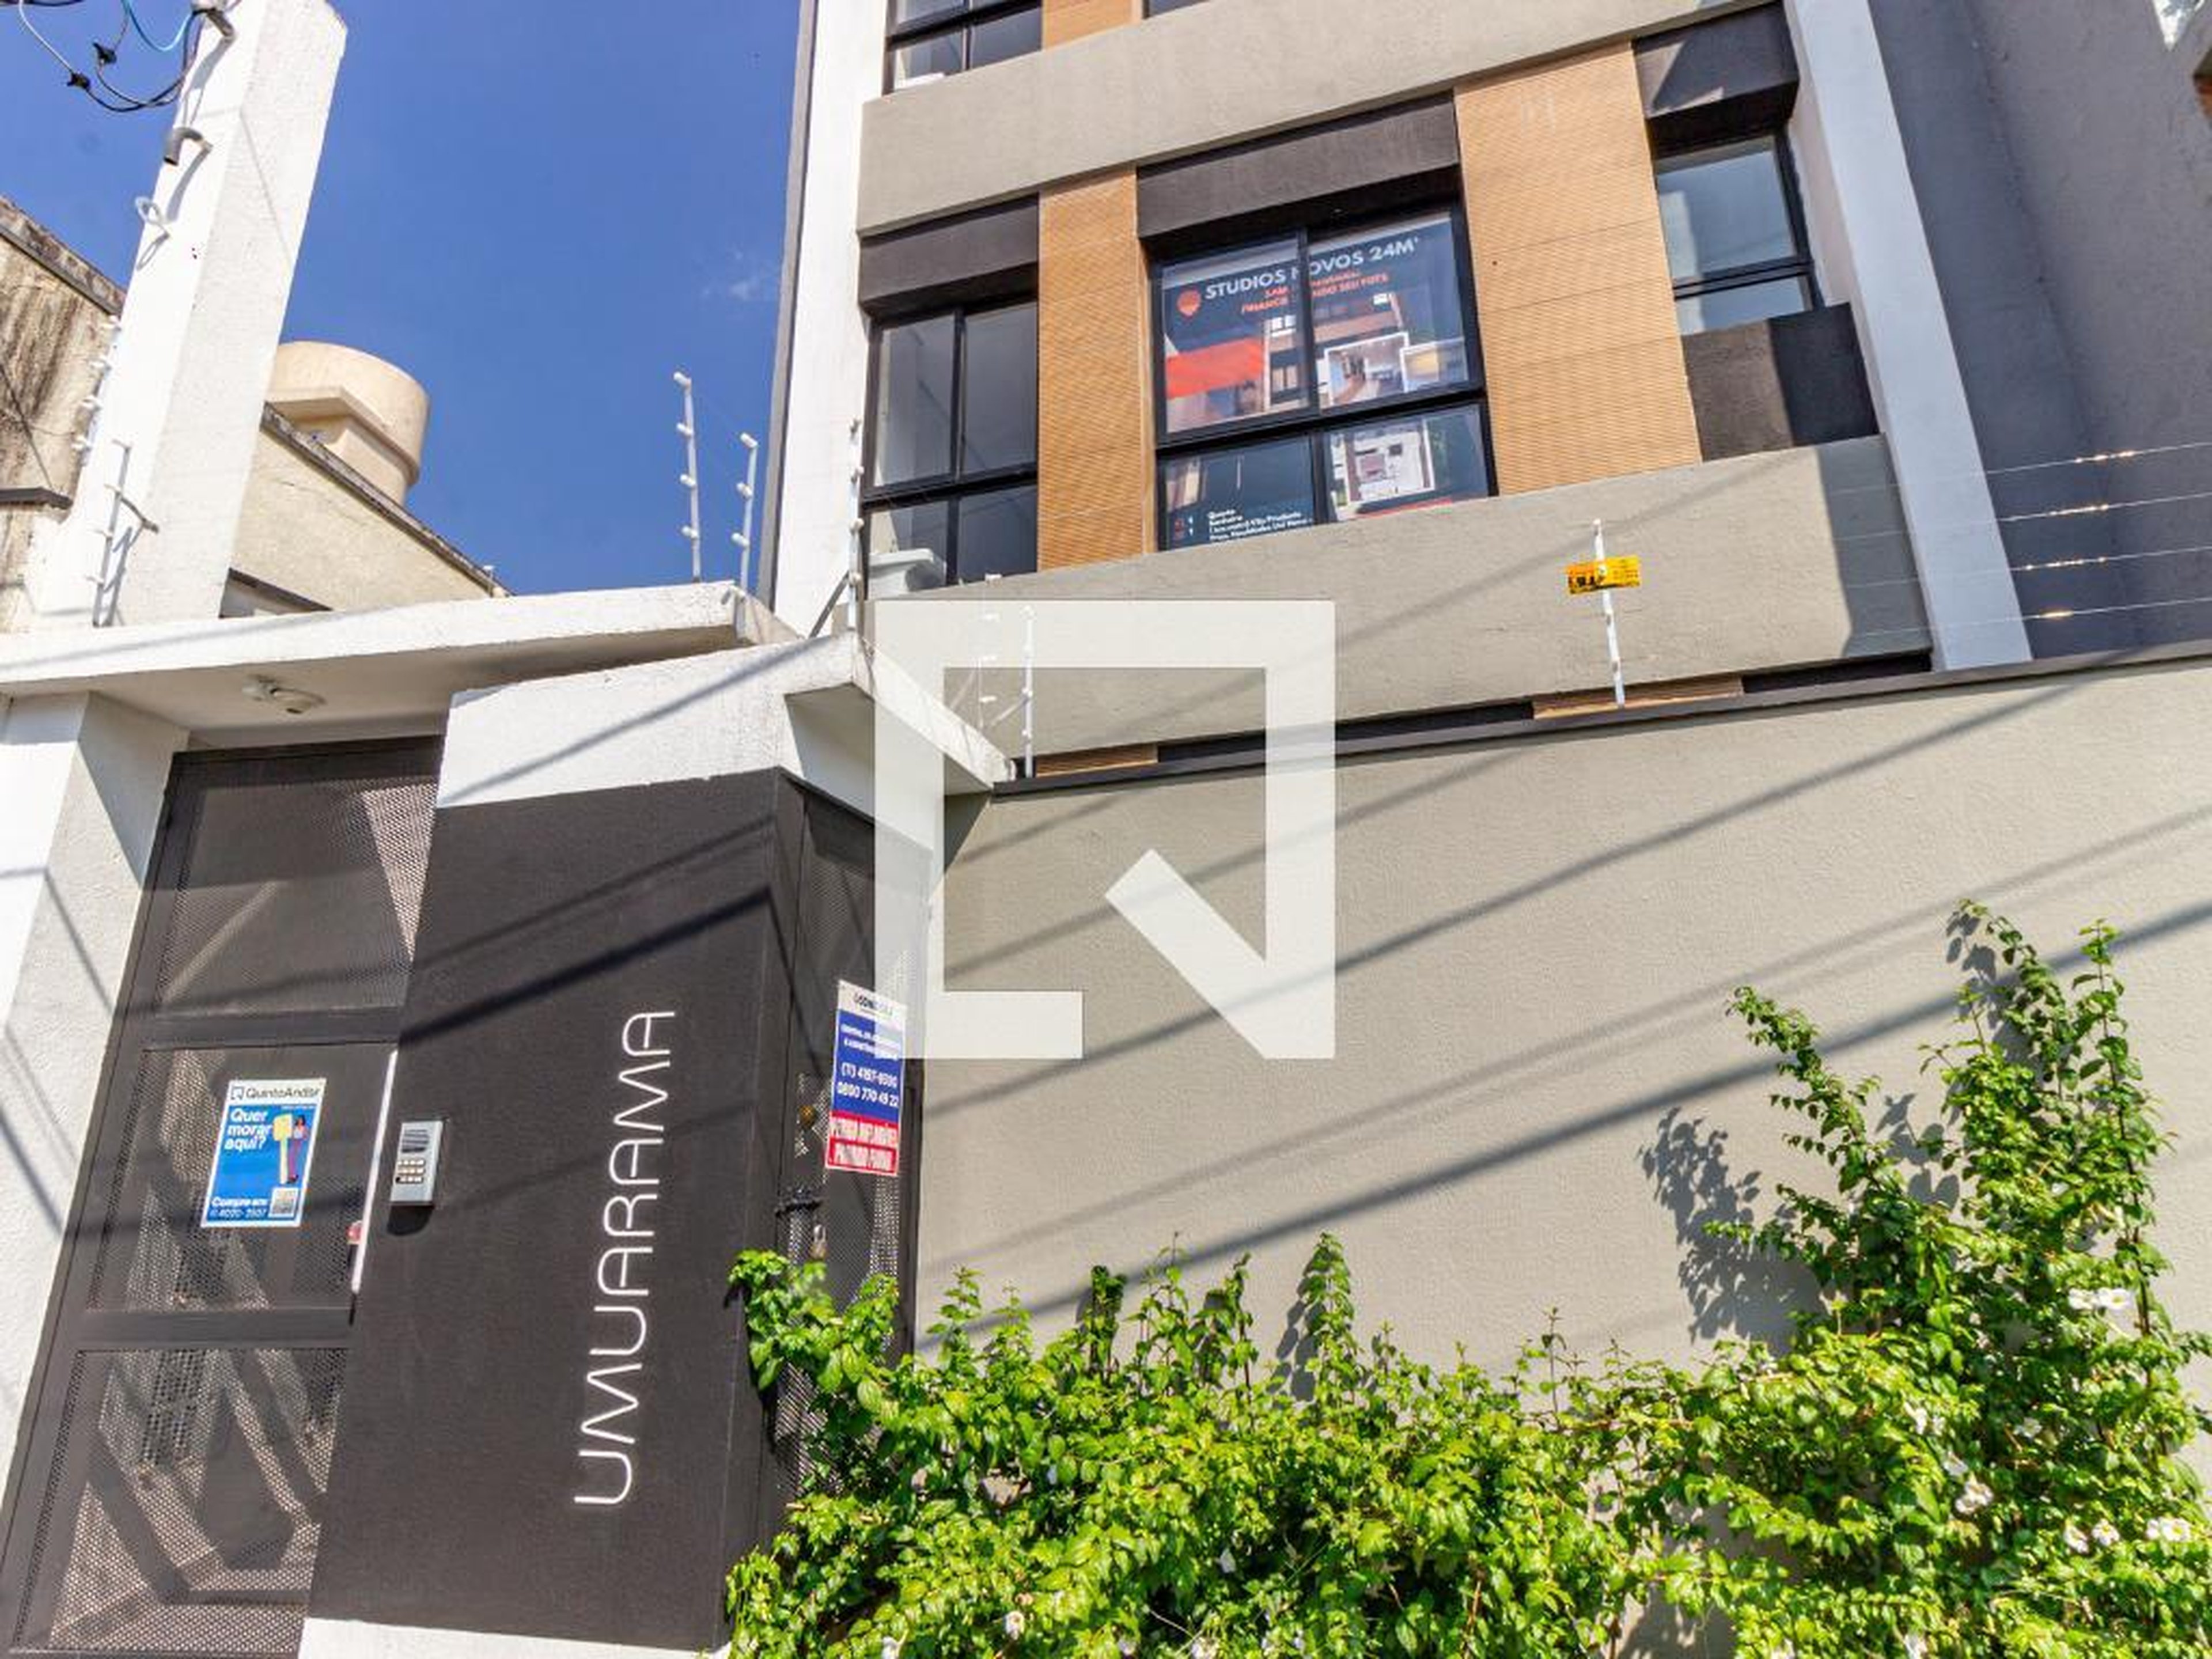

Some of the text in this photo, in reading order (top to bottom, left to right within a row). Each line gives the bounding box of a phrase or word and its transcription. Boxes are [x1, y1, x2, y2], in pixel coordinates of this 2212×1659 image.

[1206, 269, 1286, 300] STUDIOS
[230, 1108, 268, 1122] Quer
[228, 1124, 272, 1135] morar
[224, 1136, 267, 1152] aqui?
[574, 1011, 675, 1505] UMUARAMA
